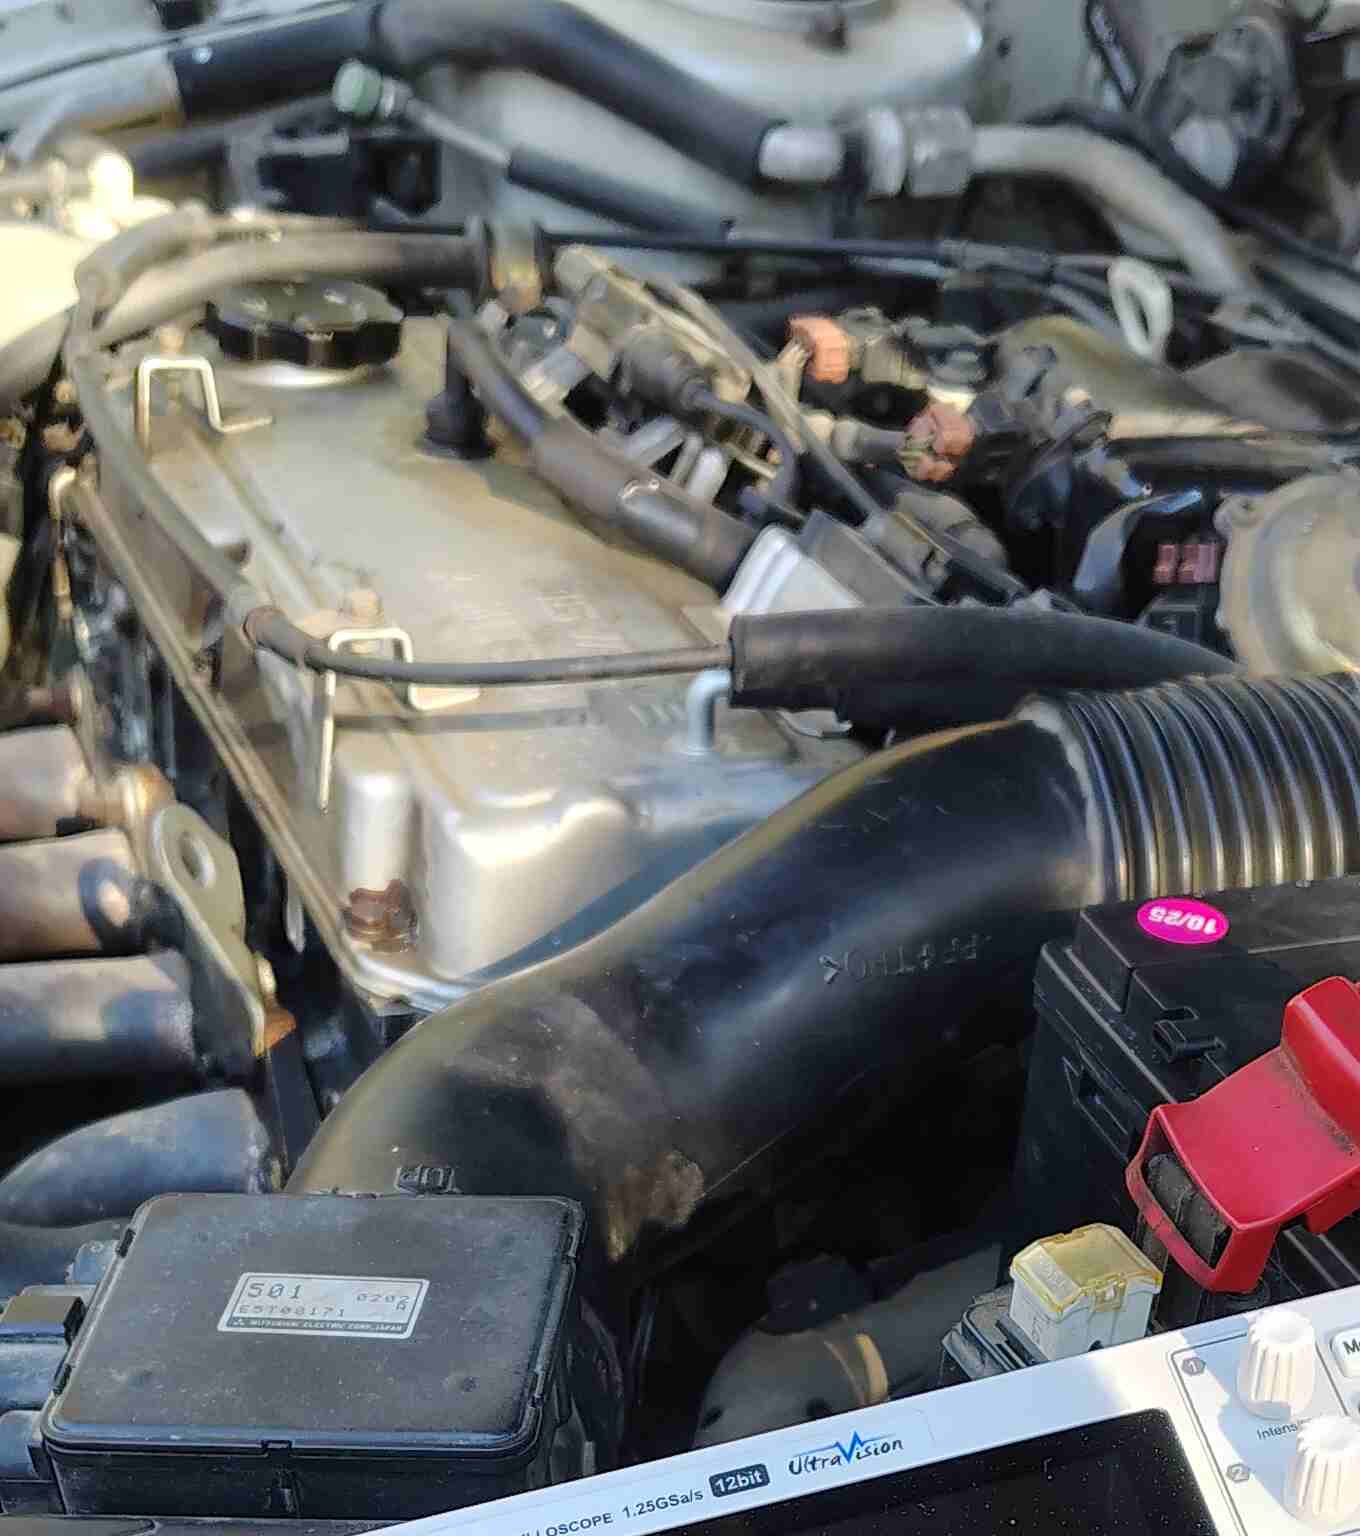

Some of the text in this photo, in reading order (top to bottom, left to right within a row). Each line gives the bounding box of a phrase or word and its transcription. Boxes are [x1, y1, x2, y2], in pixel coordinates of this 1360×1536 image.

[1148, 906, 1217, 935] 10/25
[1256, 1420, 1299, 1440] Intens
[713, 1467, 764, 1494] 12bit
[622, 1489, 704, 1520] 1.25GSa/s
